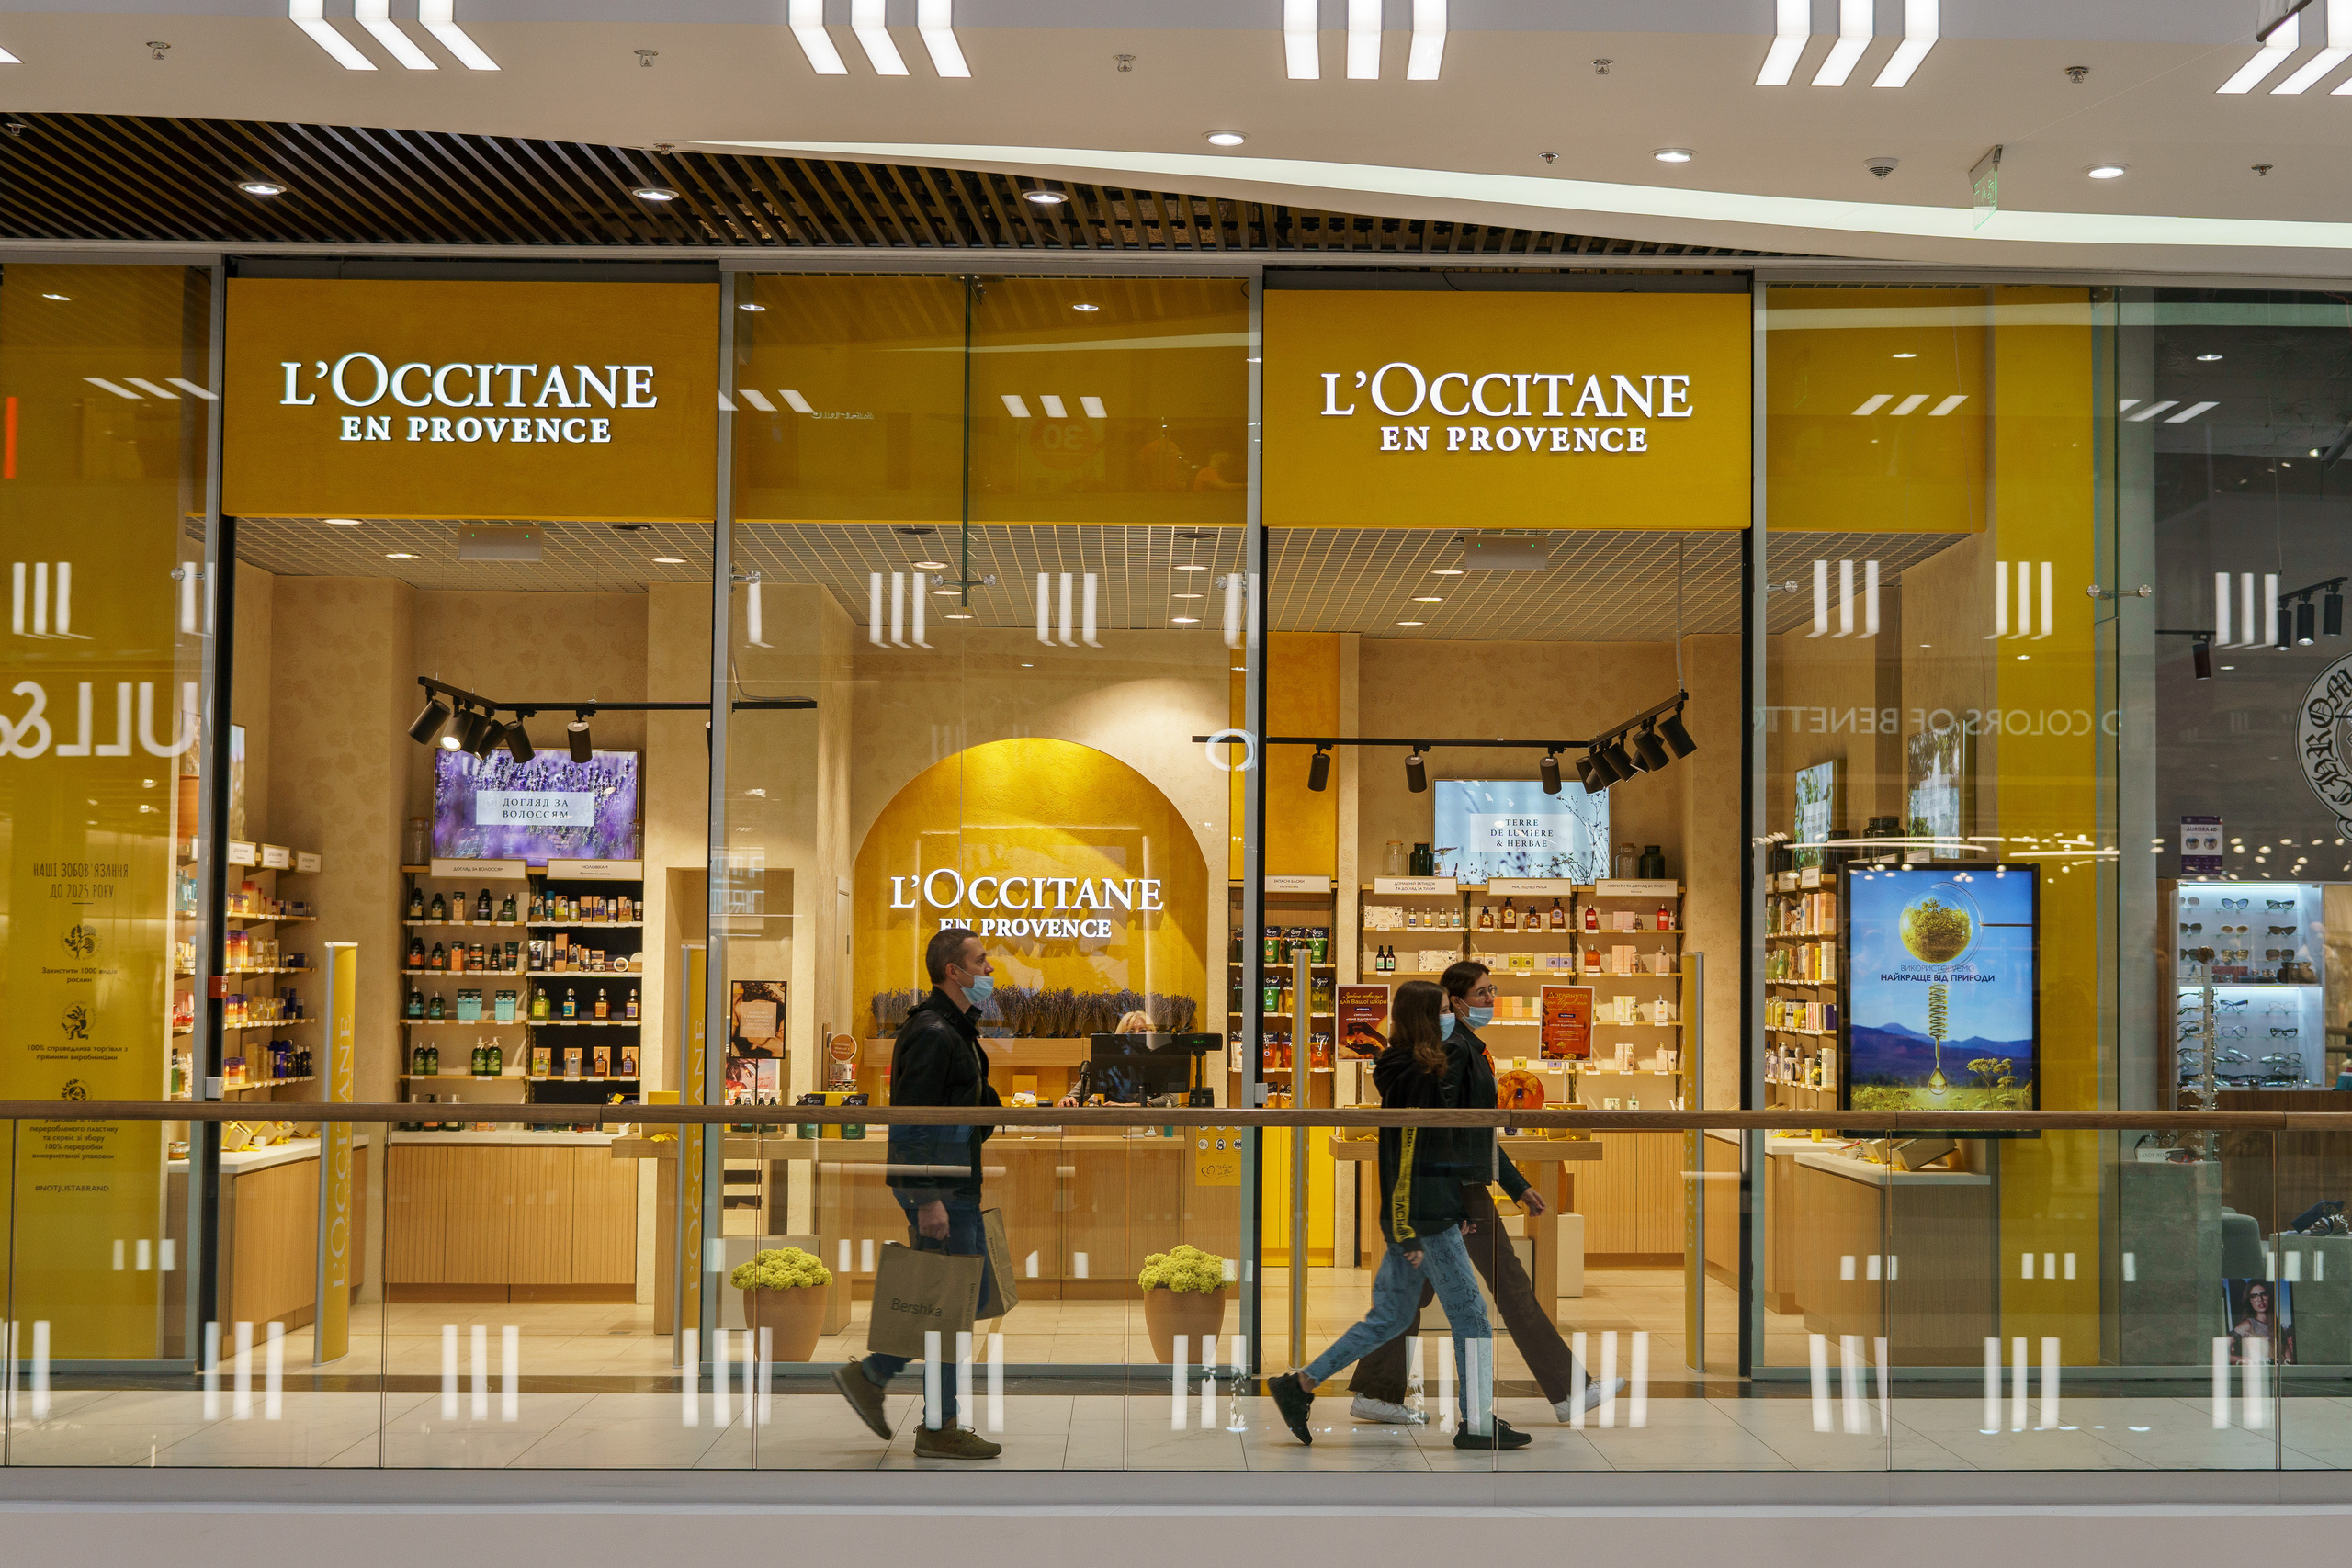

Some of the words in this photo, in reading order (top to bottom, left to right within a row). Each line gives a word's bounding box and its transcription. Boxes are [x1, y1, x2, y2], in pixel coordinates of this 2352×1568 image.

[341, 416, 391, 442] EN
[408, 416, 612, 444] PROVENCE
[1380, 426, 1429, 452] EN
[1446, 426, 1648, 453] PROVENCE
[503, 797, 550, 807] ДОГЛЯД
[554, 797, 569, 807] ЗА
[503, 809, 569, 818] ВОЛОССЯМ
[1505, 818, 1539, 827] TERRE
[1508, 828, 1554, 837] LUMIÈRE
[33, 863, 58, 877] НАШІ
[50, 884, 63, 898] ДО
[66, 884, 89, 898] 2025
[93, 884, 115, 898] РОКУ
[980, 918, 1112, 939] PROVENCE
[1881, 973, 1931, 982] НАЙКРАЩЕ
[1933, 974, 1949, 982] ВІД
[1951, 974, 1996, 982] ПРИРОДИ
[1548, 992, 1588, 1000] Доглянута
[890, 1297, 943, 1317] Bershka
